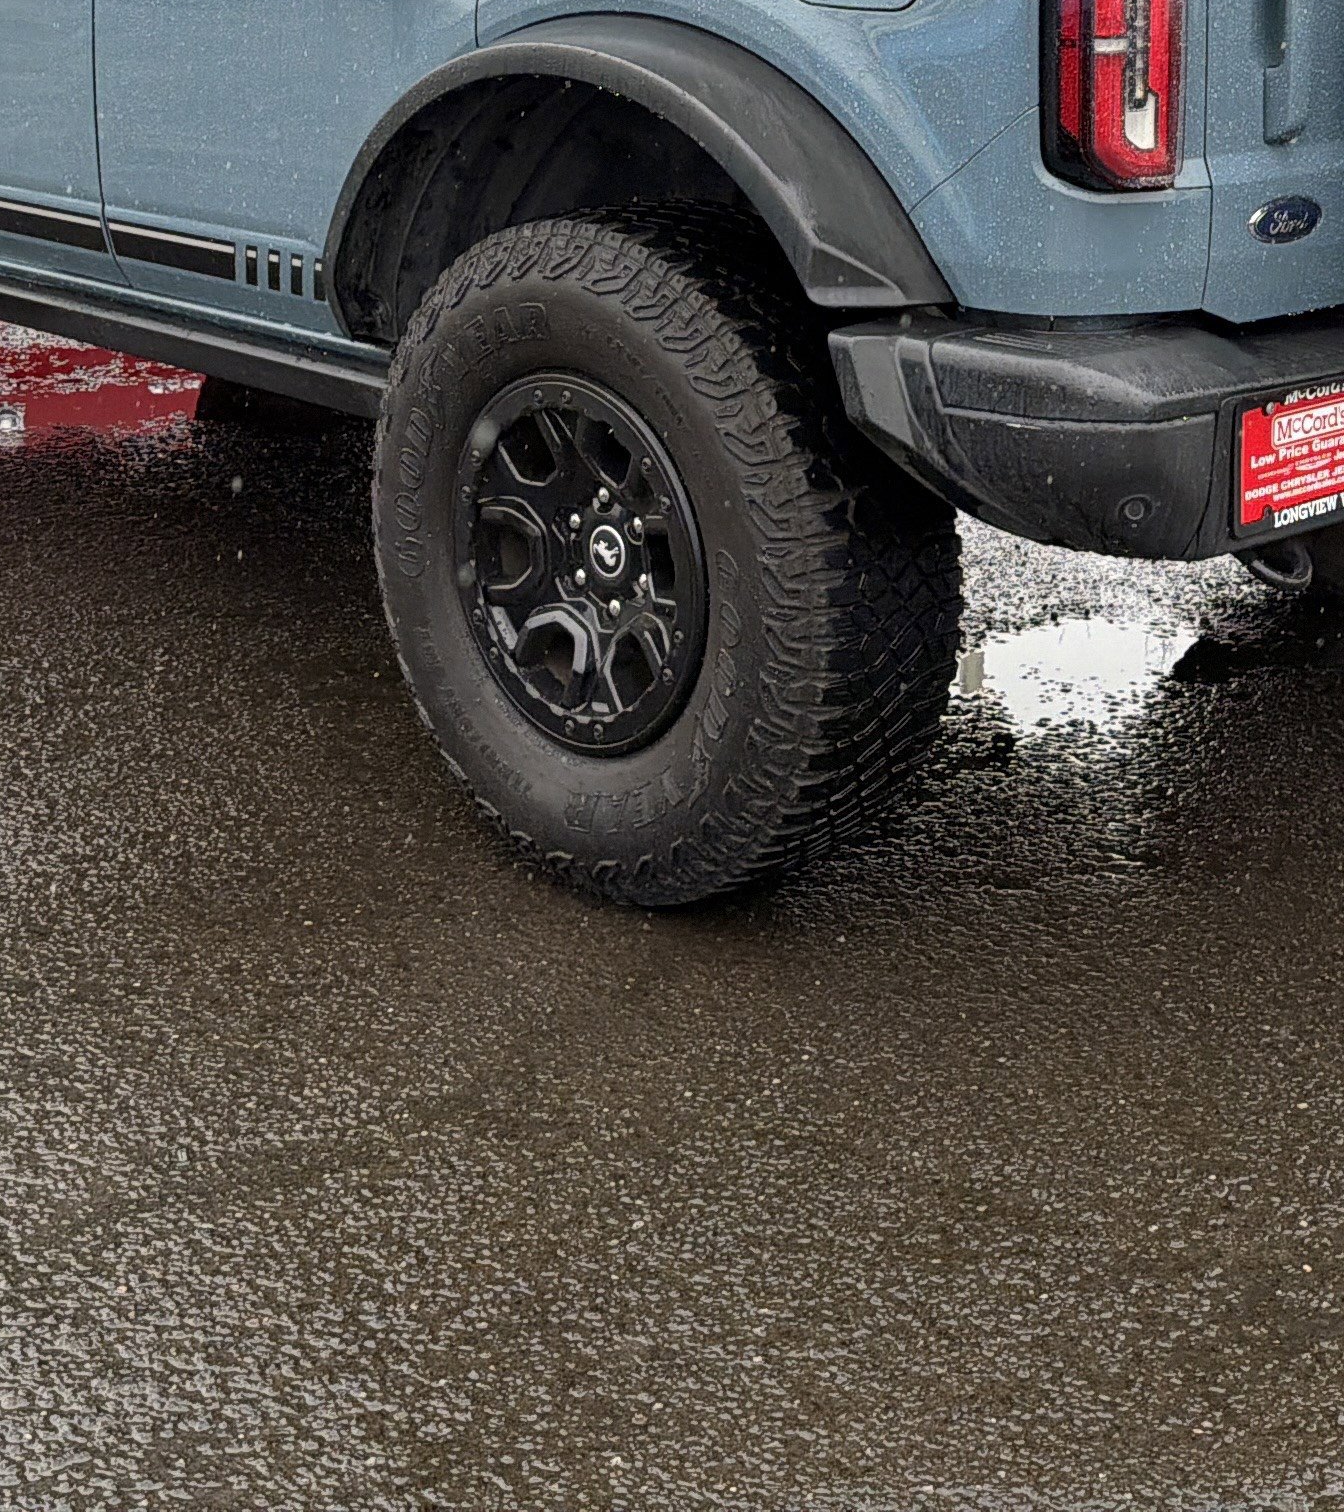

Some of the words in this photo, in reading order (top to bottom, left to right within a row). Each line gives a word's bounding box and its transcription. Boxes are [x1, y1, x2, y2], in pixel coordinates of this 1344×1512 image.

[1269, 209, 1309, 235] Ford
[1250, 453, 1276, 469] Low
[1279, 444, 1309, 462] Price
[1244, 483, 1278, 501] DODGE
[1281, 468, 1330, 489] CHRYSLER
[1273, 494, 1338, 529] LONGVIEW
